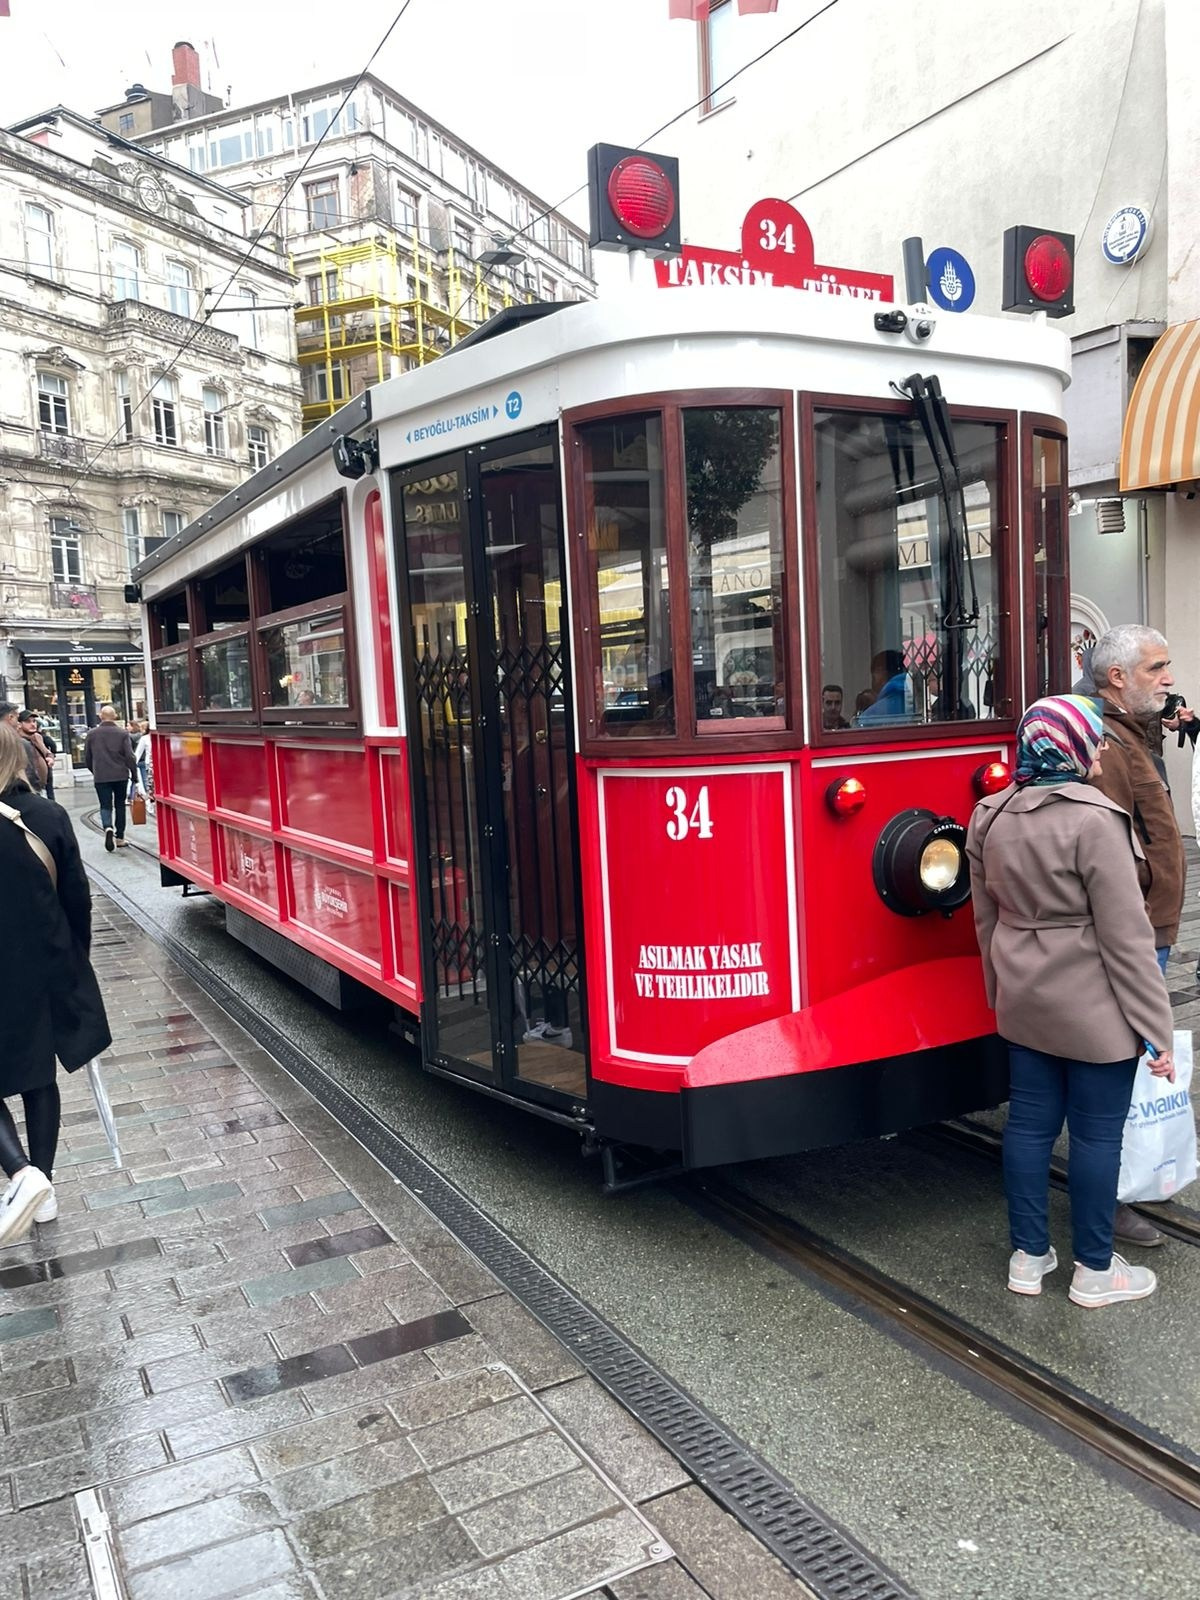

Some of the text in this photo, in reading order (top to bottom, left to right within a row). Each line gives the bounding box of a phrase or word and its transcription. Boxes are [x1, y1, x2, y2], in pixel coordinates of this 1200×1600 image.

[759, 219, 796, 254] 34
[413, 398, 520, 442] BEYOĞLU-TAKSİM T2
[665, 785, 715, 841] 34
[638, 942, 763, 971] ASILMAK YASAK
[635, 971, 770, 1000] VE TEHLIKELIDIR
